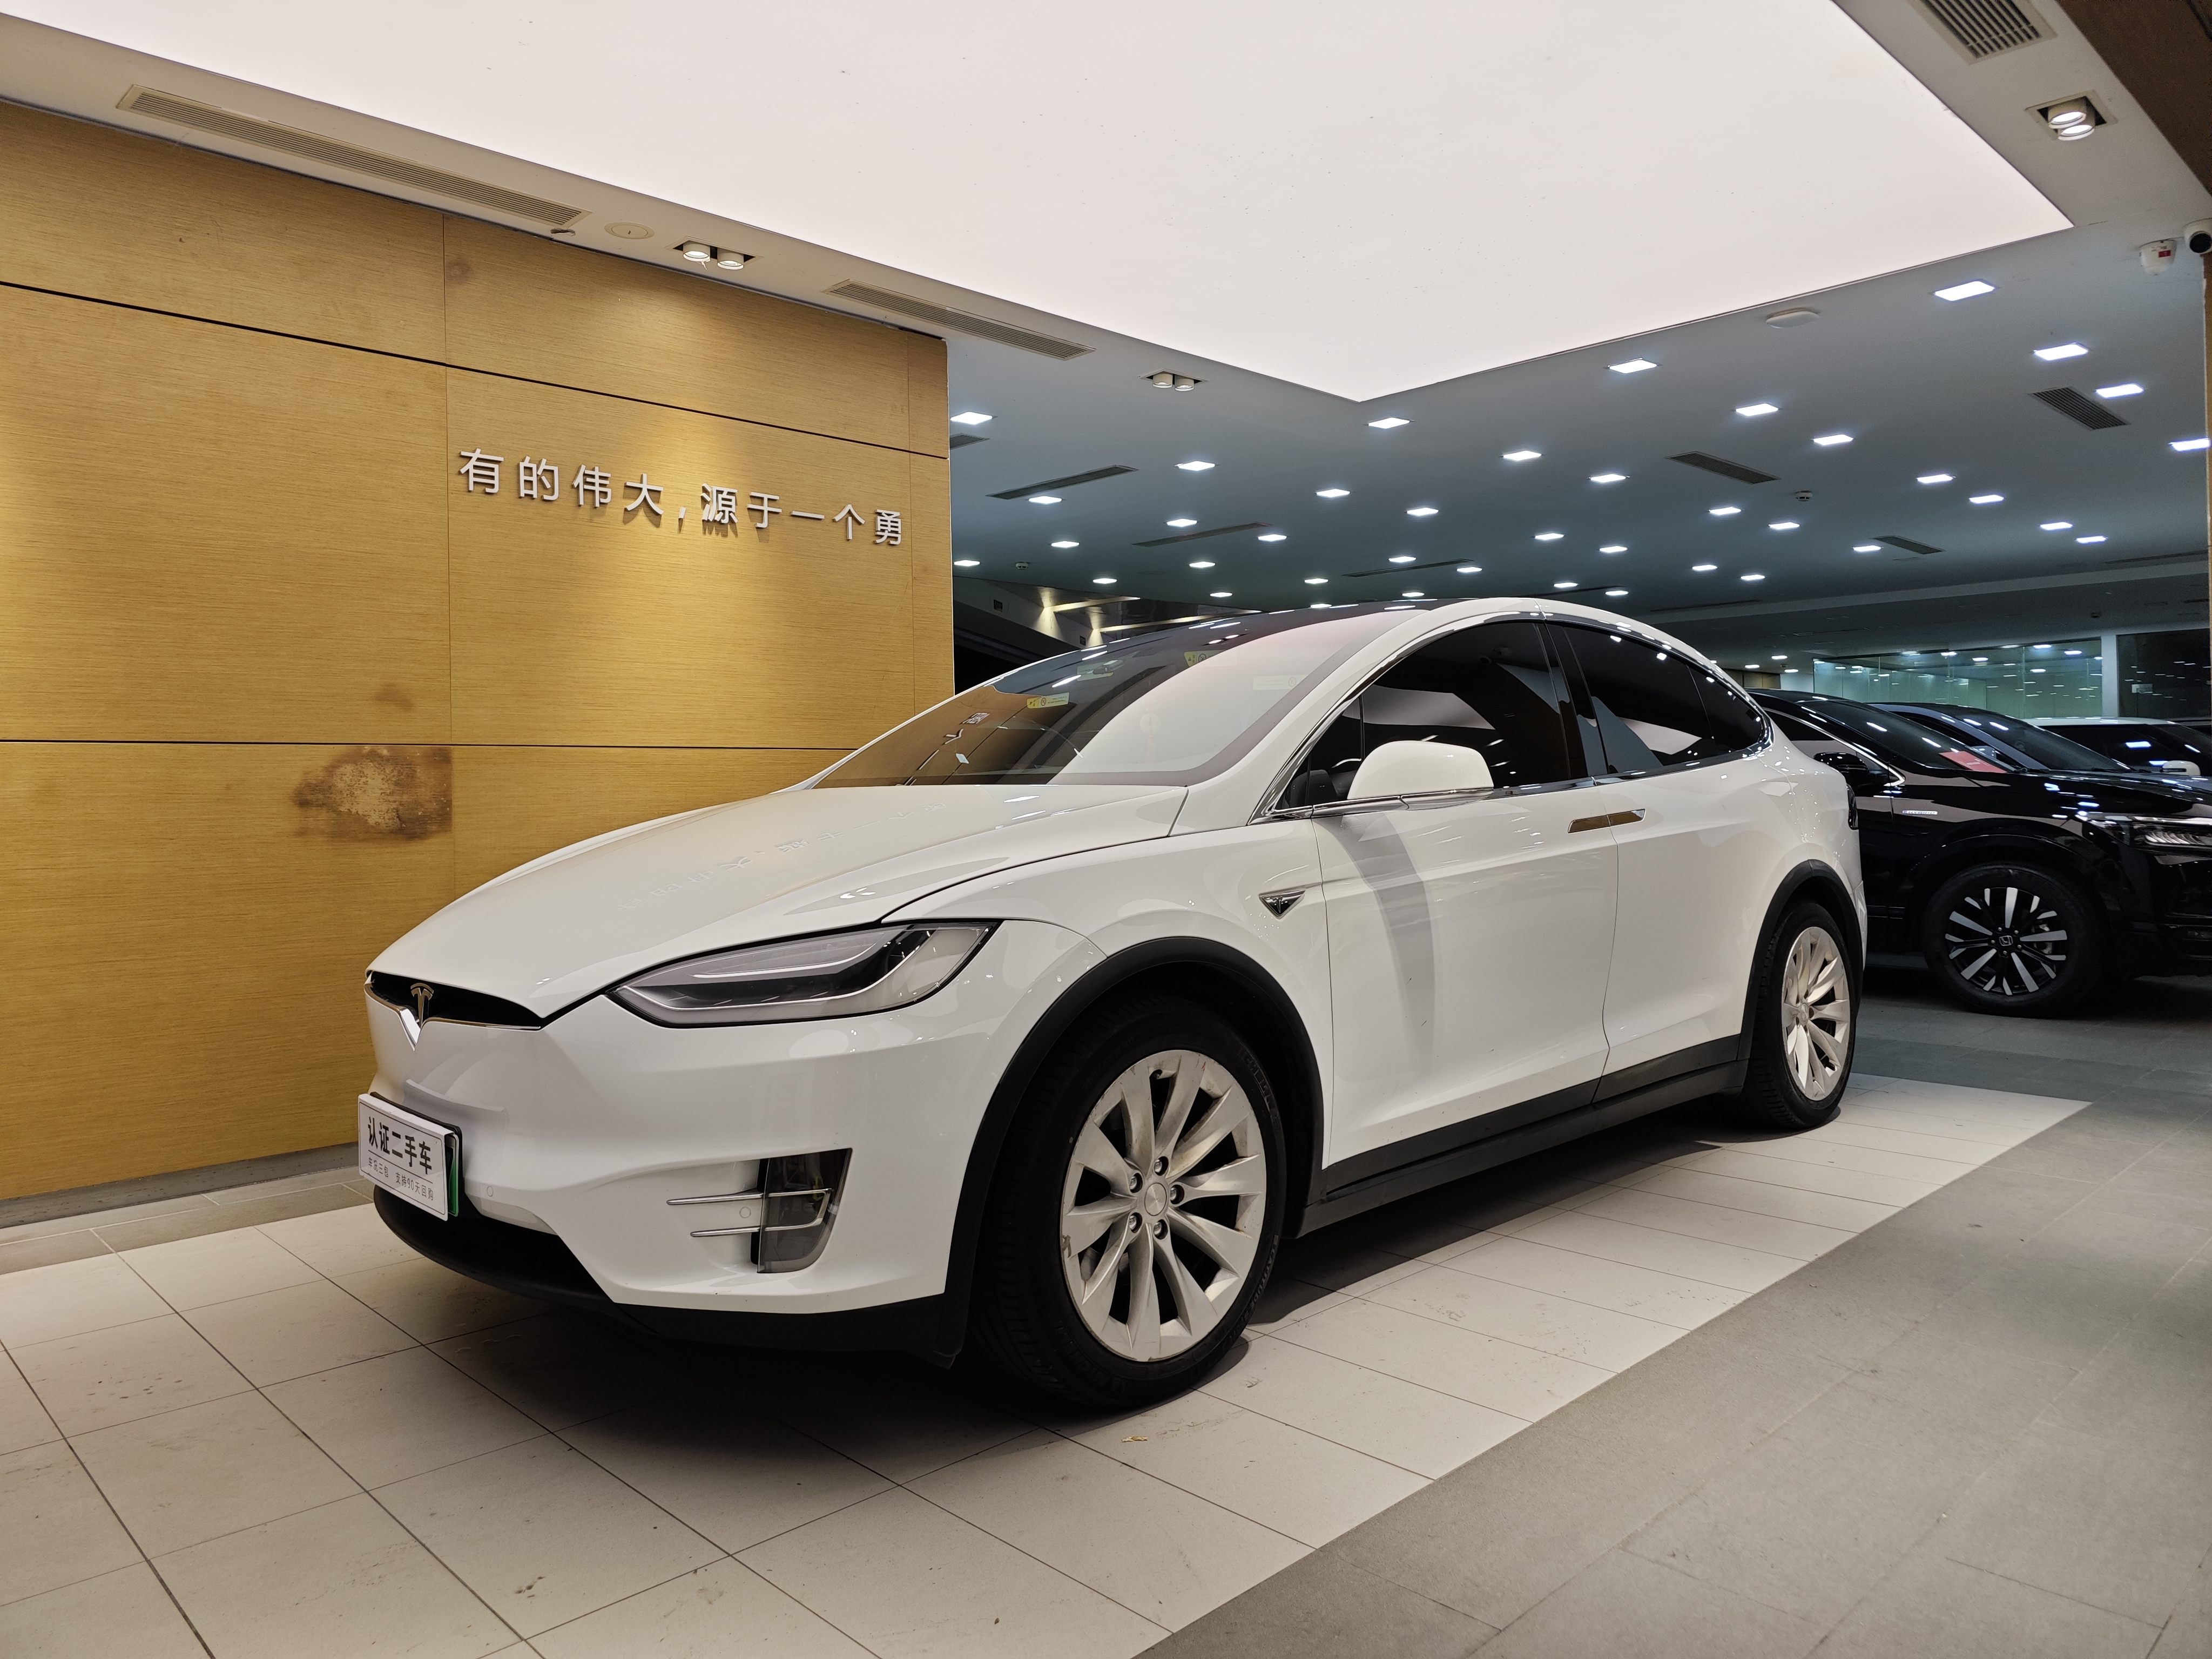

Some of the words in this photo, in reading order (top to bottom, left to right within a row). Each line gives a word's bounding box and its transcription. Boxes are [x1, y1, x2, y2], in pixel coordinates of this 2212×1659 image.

[459, 448, 902, 545] 有的伟大，源于一个勇
[368, 1116, 432, 1175] 认证二手车
